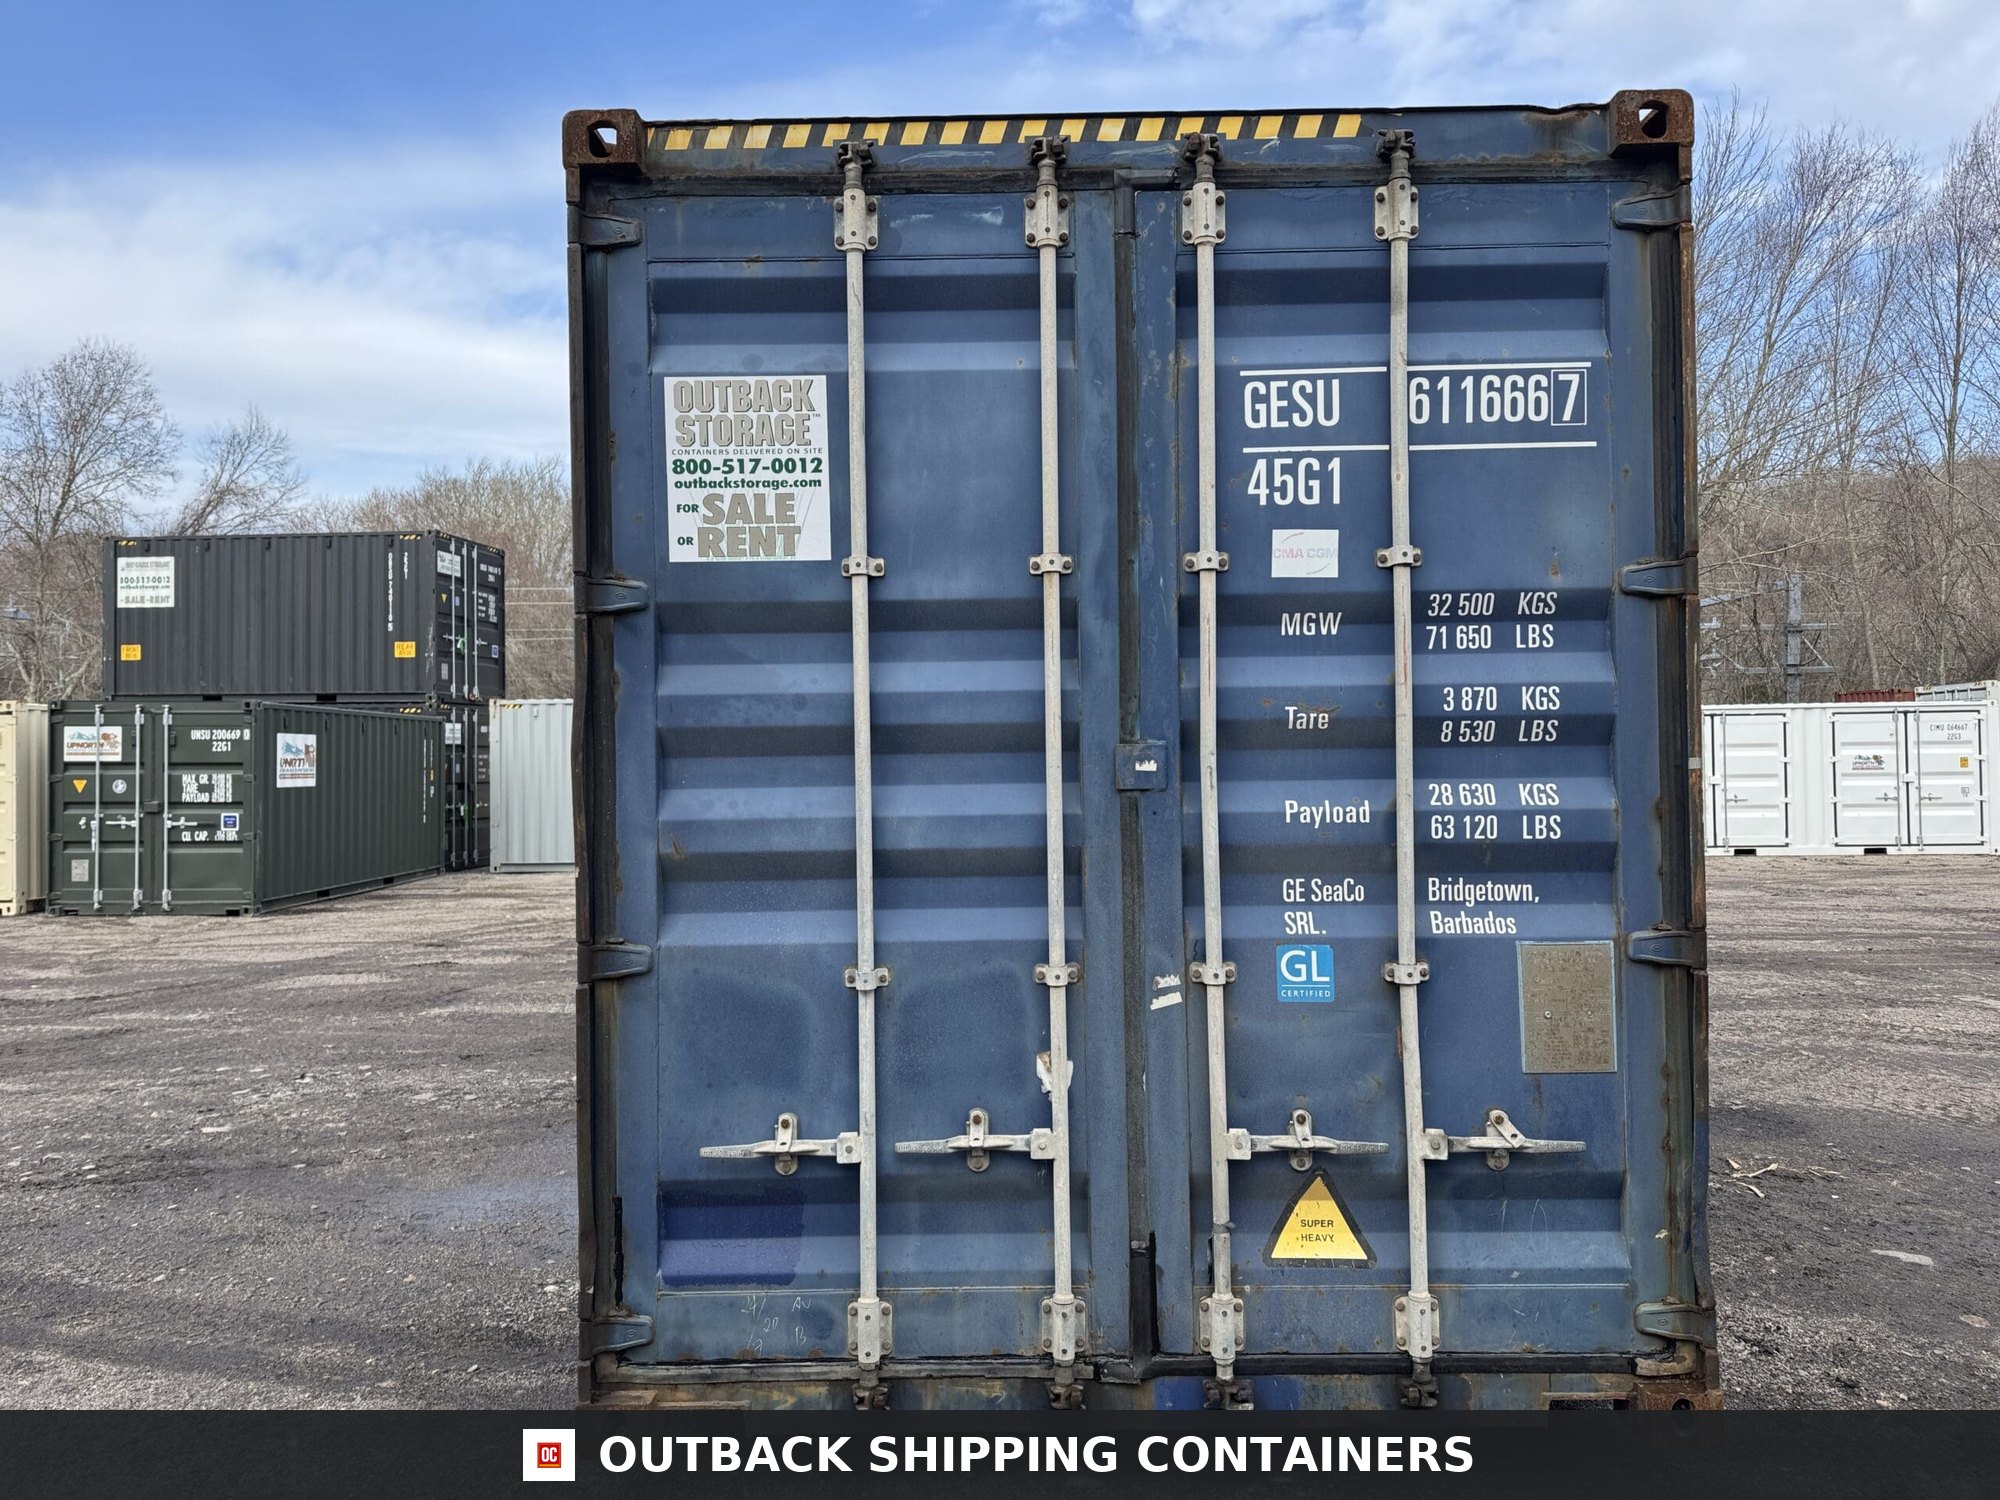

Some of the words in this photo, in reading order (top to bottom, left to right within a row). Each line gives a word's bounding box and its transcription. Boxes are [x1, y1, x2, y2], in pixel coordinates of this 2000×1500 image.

[673, 379, 816, 414] OUTBACK
[1244, 378, 1340, 428] GESU
[675, 414, 812, 448] STORAGE
[672, 448, 730, 456] CONTAINERS
[672, 457, 823, 475] 800-517-0012
[674, 477, 822, 490] outbackstorage.com
[1247, 457, 1341, 505] 45G1
[676, 504, 699, 513] FOR
[702, 493, 796, 525] SALE
[677, 536, 694, 546] OR
[697, 526, 801, 558] RENT
[1274, 548, 1304, 559] CMA
[1428, 593, 1452, 616] 32
[1458, 593, 1495, 616] 500
[1518, 591, 1558, 615] KGS
[1281, 612, 1342, 635] MGW
[1426, 625, 1447, 649] 71
[1456, 625, 1492, 649] 650
[1516, 624, 1554, 648] LBS
[1443, 687, 1454, 711] 3
[1461, 686, 1497, 711] 870
[1522, 686, 1560, 711] KGS
[1284, 706, 1329, 730] Tare
[191, 729, 211, 740] UNSU
[212, 729, 241, 740] 200669
[1440, 721, 1452, 743] 8
[1458, 720, 1495, 742] 530
[1518, 719, 1558, 742] LBS
[1428, 784, 1453, 806] 28
[1459, 783, 1496, 806] 630
[1518, 783, 1560, 806] KGS
[1284, 800, 1371, 829] Payload
[1430, 816, 1454, 839] 63
[1463, 815, 1498, 839] 120
[1522, 815, 1562, 839] LBS
[1282, 879, 1306, 903] GE
[1311, 878, 1365, 903] SeaCo
[1428, 877, 1540, 907] Bridgetown,
[1284, 911, 1327, 935] SRL.
[1429, 911, 1517, 935] Barbados
[1280, 949, 1330, 982] GL
[1281, 989, 1331, 998] CERTIFIED
[1300, 1219, 1334, 1228] SUPER
[1301, 1234, 1334, 1243] HEAVY
